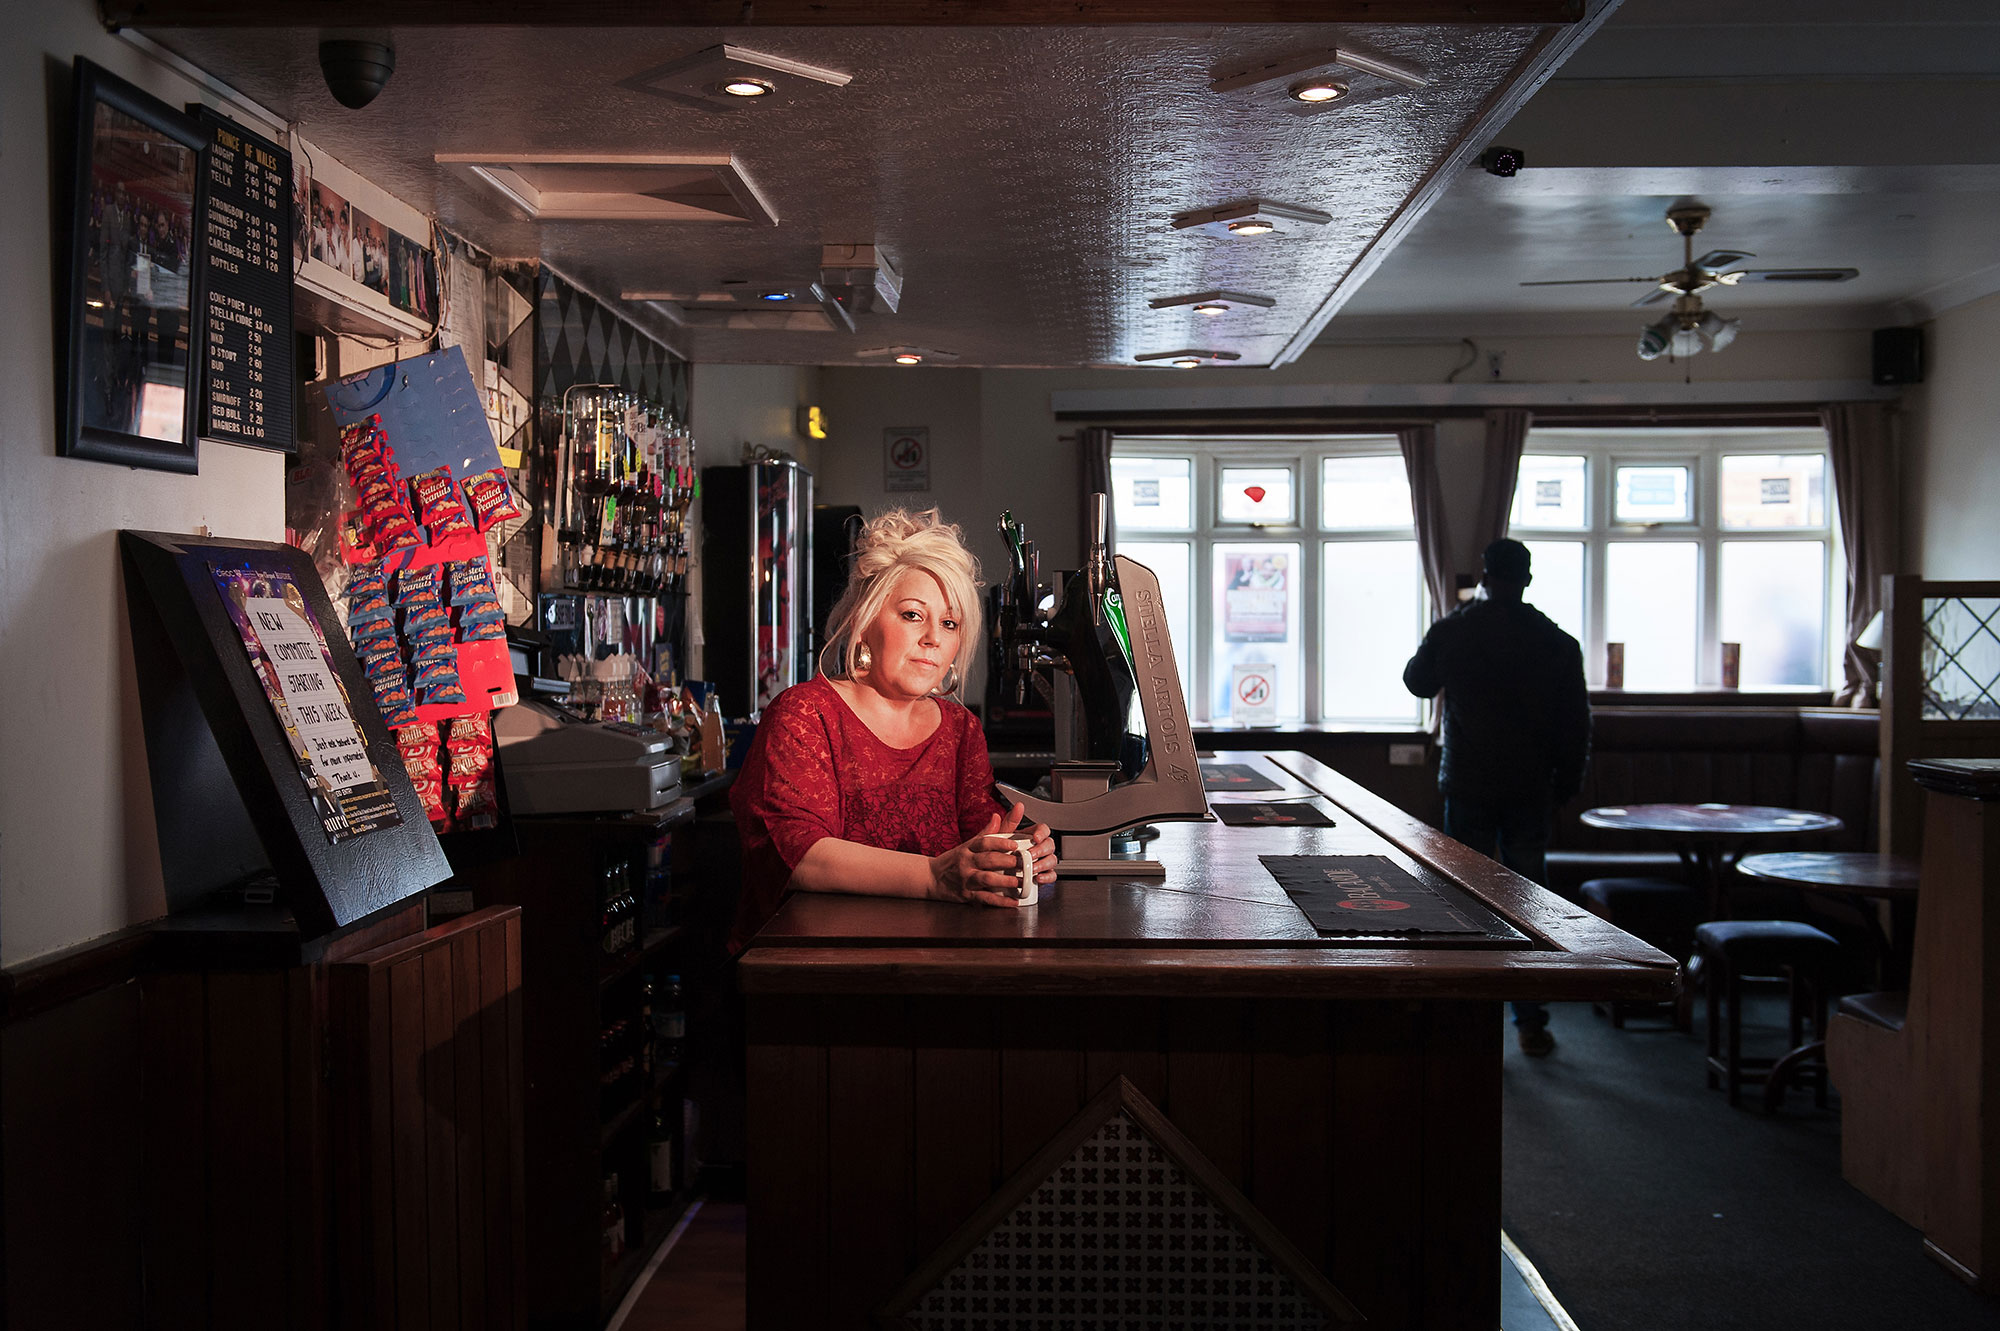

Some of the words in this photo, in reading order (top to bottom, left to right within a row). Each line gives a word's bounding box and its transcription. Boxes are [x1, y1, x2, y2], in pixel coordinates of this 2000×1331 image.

[217, 128, 240, 151] PRINCE
[245, 143, 253, 158] OF
[256, 148, 277, 171] WALES
[245, 161, 259, 175] PINT
[209, 209, 238, 230] GUINNESS
[208, 222, 231, 240] BITTER
[208, 236, 244, 259] CARLSBERG
[211, 255, 239, 274] BOTTLES
[209, 291, 226, 306] COKE
[210, 305, 234, 322] STELLA
[210, 318, 225, 332] PILS
[210, 332, 224, 344] WKD
[211, 359, 224, 372] BUD
[212, 391, 241, 407] SMIRNOFF
[212, 405, 225, 417] RED
[226, 408, 242, 421] BULL
[212, 418, 240, 433] MAGNERS
[420, 480, 445, 497] Salted
[422, 486, 451, 505] Peanuts
[476, 486, 501, 504] Salted
[478, 493, 507, 514] Peanuts
[256, 611, 283, 631] NEW
[274, 642, 318, 662] COMMITTEE
[1135, 589, 1164, 669] STELLA
[1152, 676, 1181, 755] ARTOIS
[287, 673, 325, 693] STARTING
[298, 705, 321, 725] THIS
[312, 738, 328, 751] Just
[406, 762, 424, 775] hilli
[332, 772, 352, 785] Thank
[324, 815, 349, 832] aura
